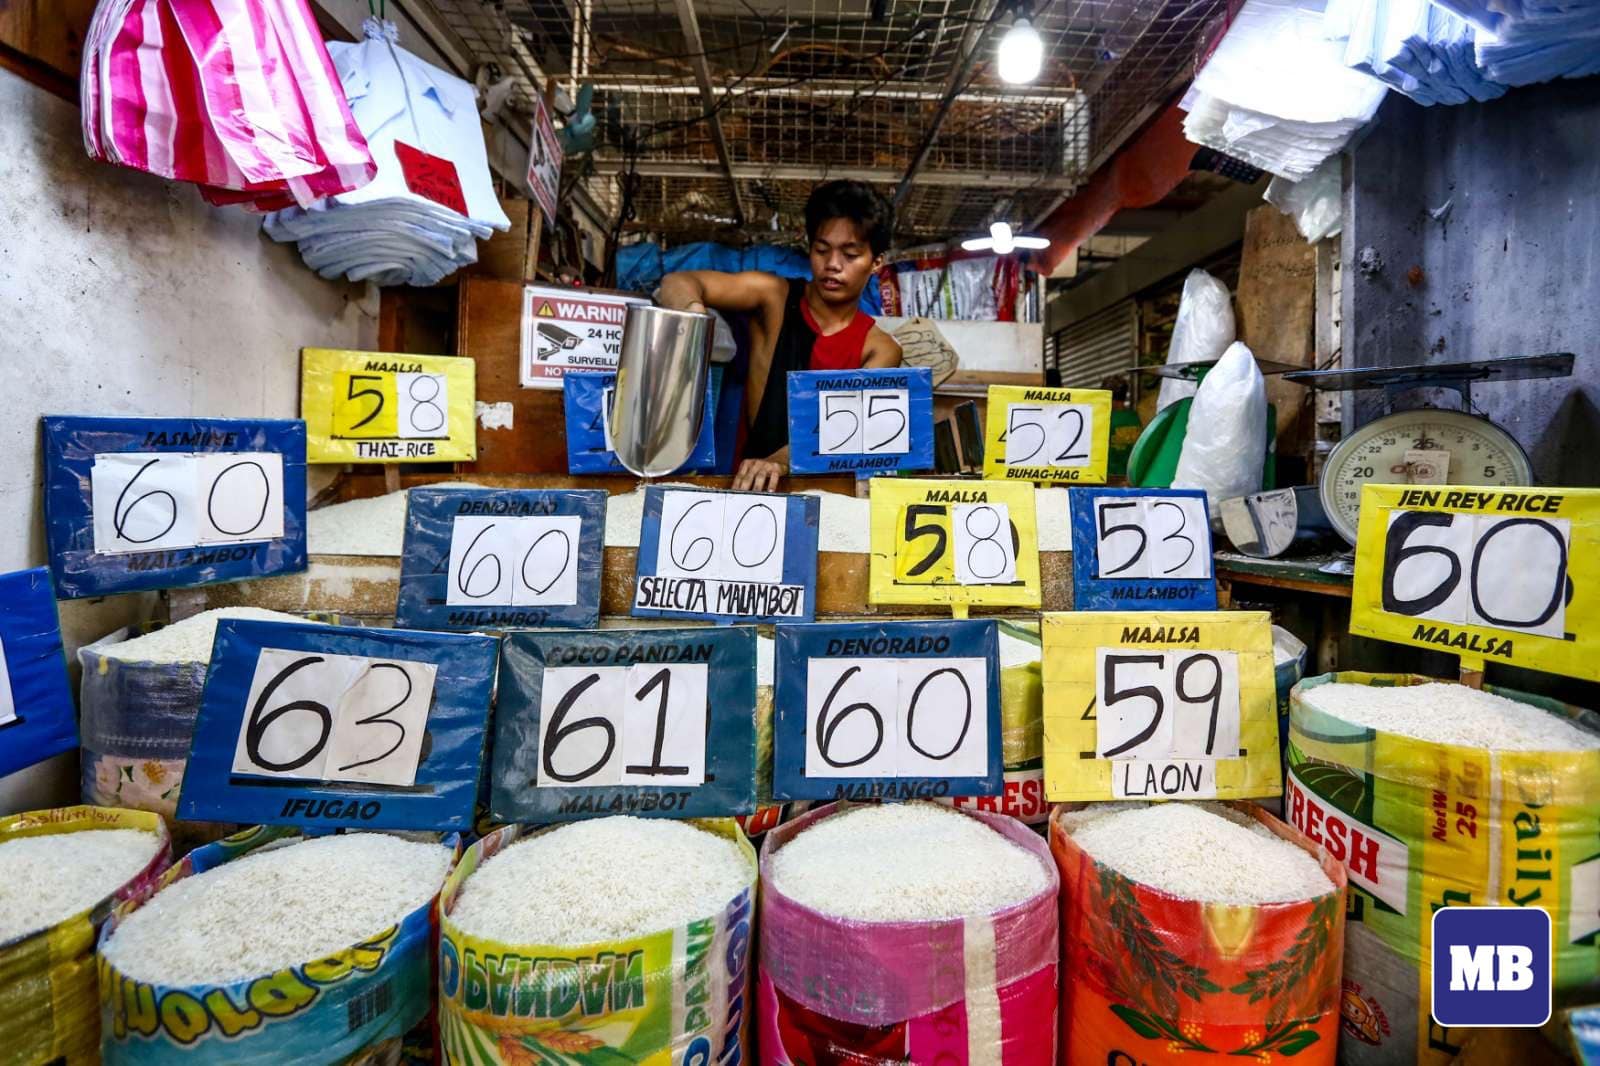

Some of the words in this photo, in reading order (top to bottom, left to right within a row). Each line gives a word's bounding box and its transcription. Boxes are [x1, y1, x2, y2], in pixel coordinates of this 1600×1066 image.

[556, 301, 626, 321] WARNIN
[587, 328, 602, 340] 24
[364, 360, 424, 374] MAALSA
[544, 366, 563, 378] NO
[567, 355, 618, 367] SURVEILL
[815, 374, 909, 391] SINANDOMENG
[347, 375, 445, 432] 58
[1023, 389, 1072, 403] MAALSA
[825, 395, 906, 451] 55
[1009, 406, 1088, 465] 52
[1383, 438, 1396, 446] 23
[1456, 435, 1463, 443] 2
[356, 441, 436, 458] THAI-RICE
[1472, 443, 1480, 451] 3
[828, 455, 902, 471] MALAMBOT
[1005, 467, 1080, 481] BUHAG-HAG
[1352, 466, 1375, 479] 20
[1483, 466, 1496, 478] 5
[113, 458, 270, 544] 60
[925, 489, 988, 504] MAALSA
[1344, 491, 1357, 499] 18
[1397, 489, 1442, 508] JEN
[1443, 493, 1496, 510] REY
[1498, 493, 1564, 513] RICE
[458, 500, 559, 516] DENORADO
[670, 499, 778, 572] 60
[904, 503, 1008, 580] 58
[1100, 501, 1195, 575] 53
[127, 545, 259, 571] MALAMBOT
[458, 524, 570, 599] 60
[1381, 510, 1569, 628] 60
[637, 579, 709, 614] SELECTA
[716, 583, 803, 617] MALAMBOT
[1111, 585, 1200, 601] MALAMBOT
[447, 610, 551, 626] MALAMBOT
[826, 635, 950, 657] DENORADO
[1120, 626, 1201, 645] MAALSA
[1412, 624, 1514, 659] MAALSA
[612, 643, 715, 664] PANDAN
[245, 655, 413, 773] 63
[815, 665, 972, 768] 60
[1103, 653, 1223, 758] 59
[543, 667, 690, 783] 61
[1124, 764, 1202, 797] LAON
[279, 797, 382, 822] IFUGAO
[557, 791, 691, 814] MALAMBOT
[1286, 776, 1380, 886] FRESH
[1456, 802, 1477, 839] 25
